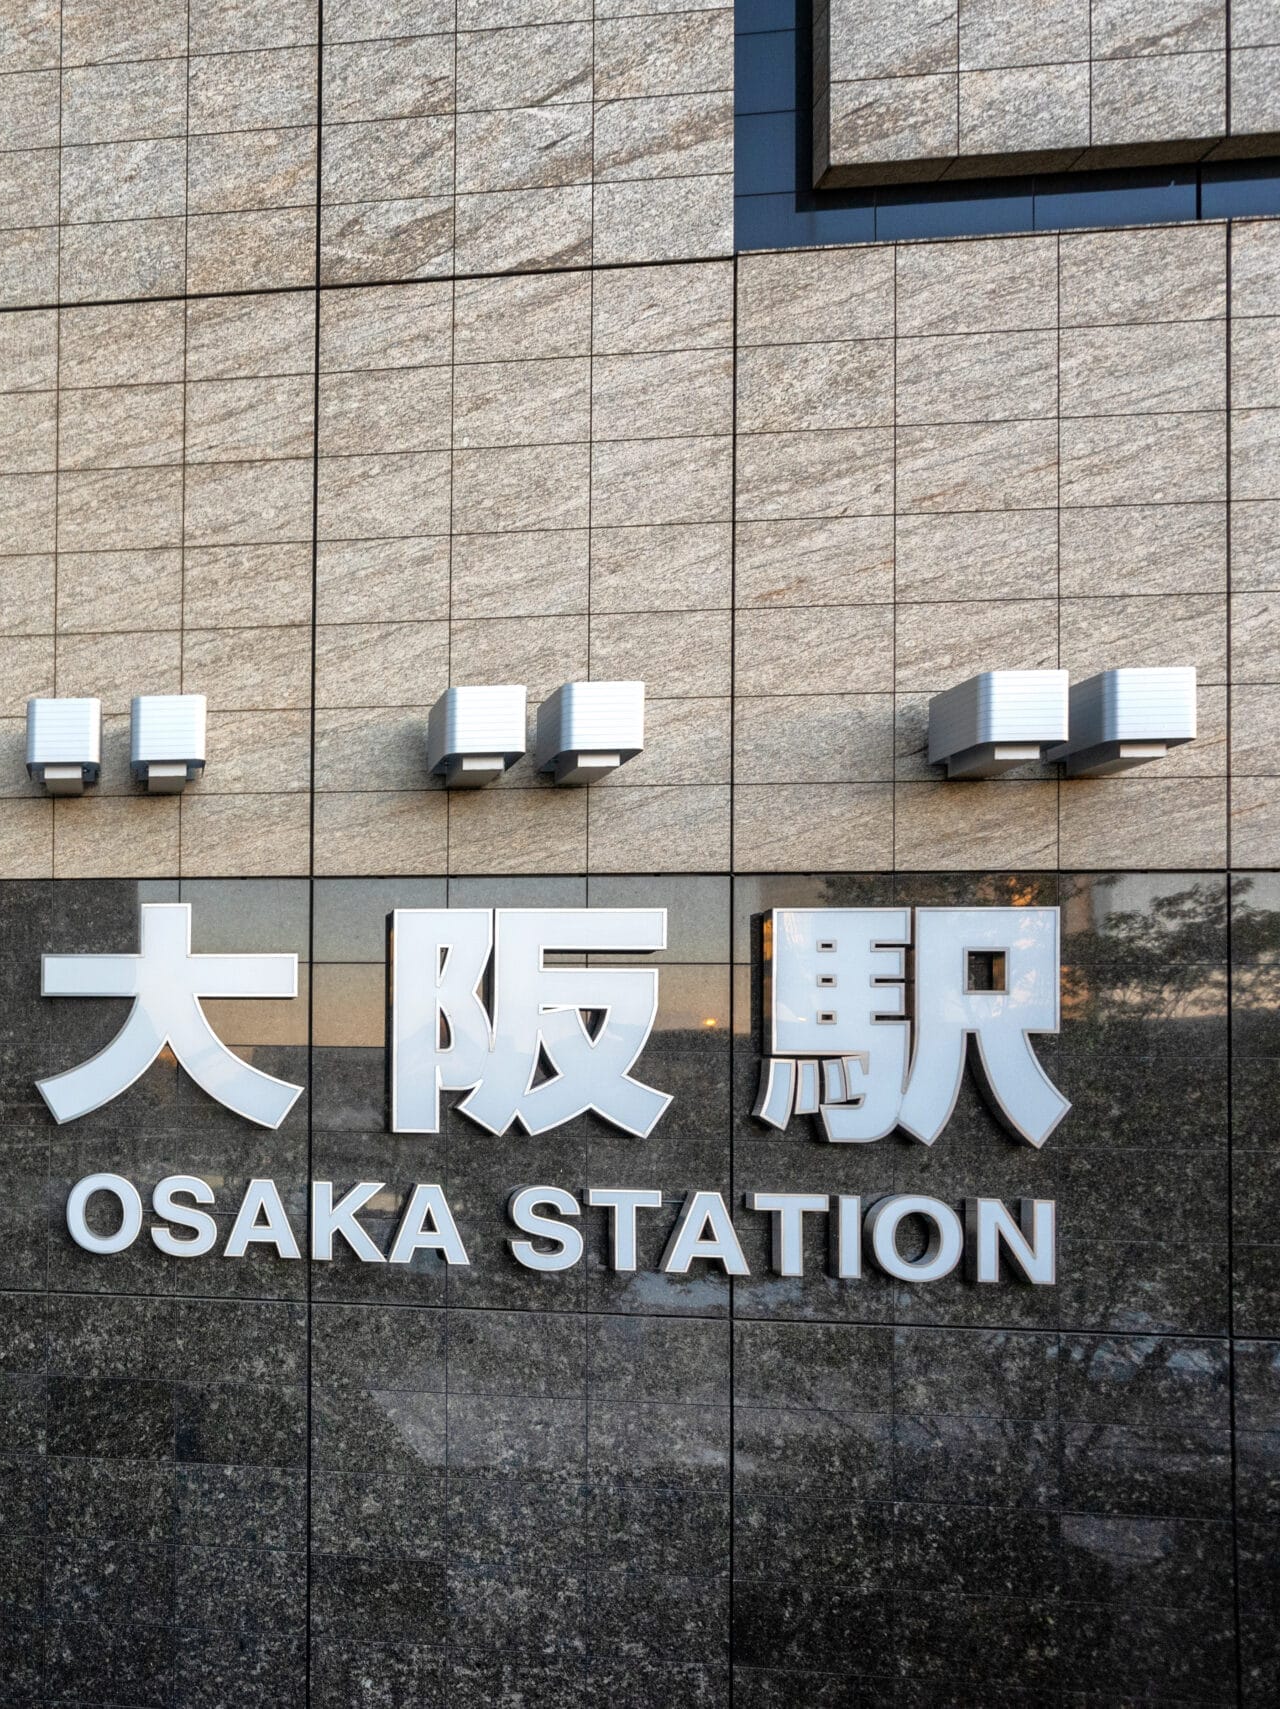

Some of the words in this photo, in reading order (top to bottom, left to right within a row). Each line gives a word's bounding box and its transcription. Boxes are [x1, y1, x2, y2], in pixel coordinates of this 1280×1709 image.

[34, 902, 1072, 1149] 大阪駅
[65, 1172, 470, 1266] OSAKA
[510, 1185, 1057, 1287] STATION
